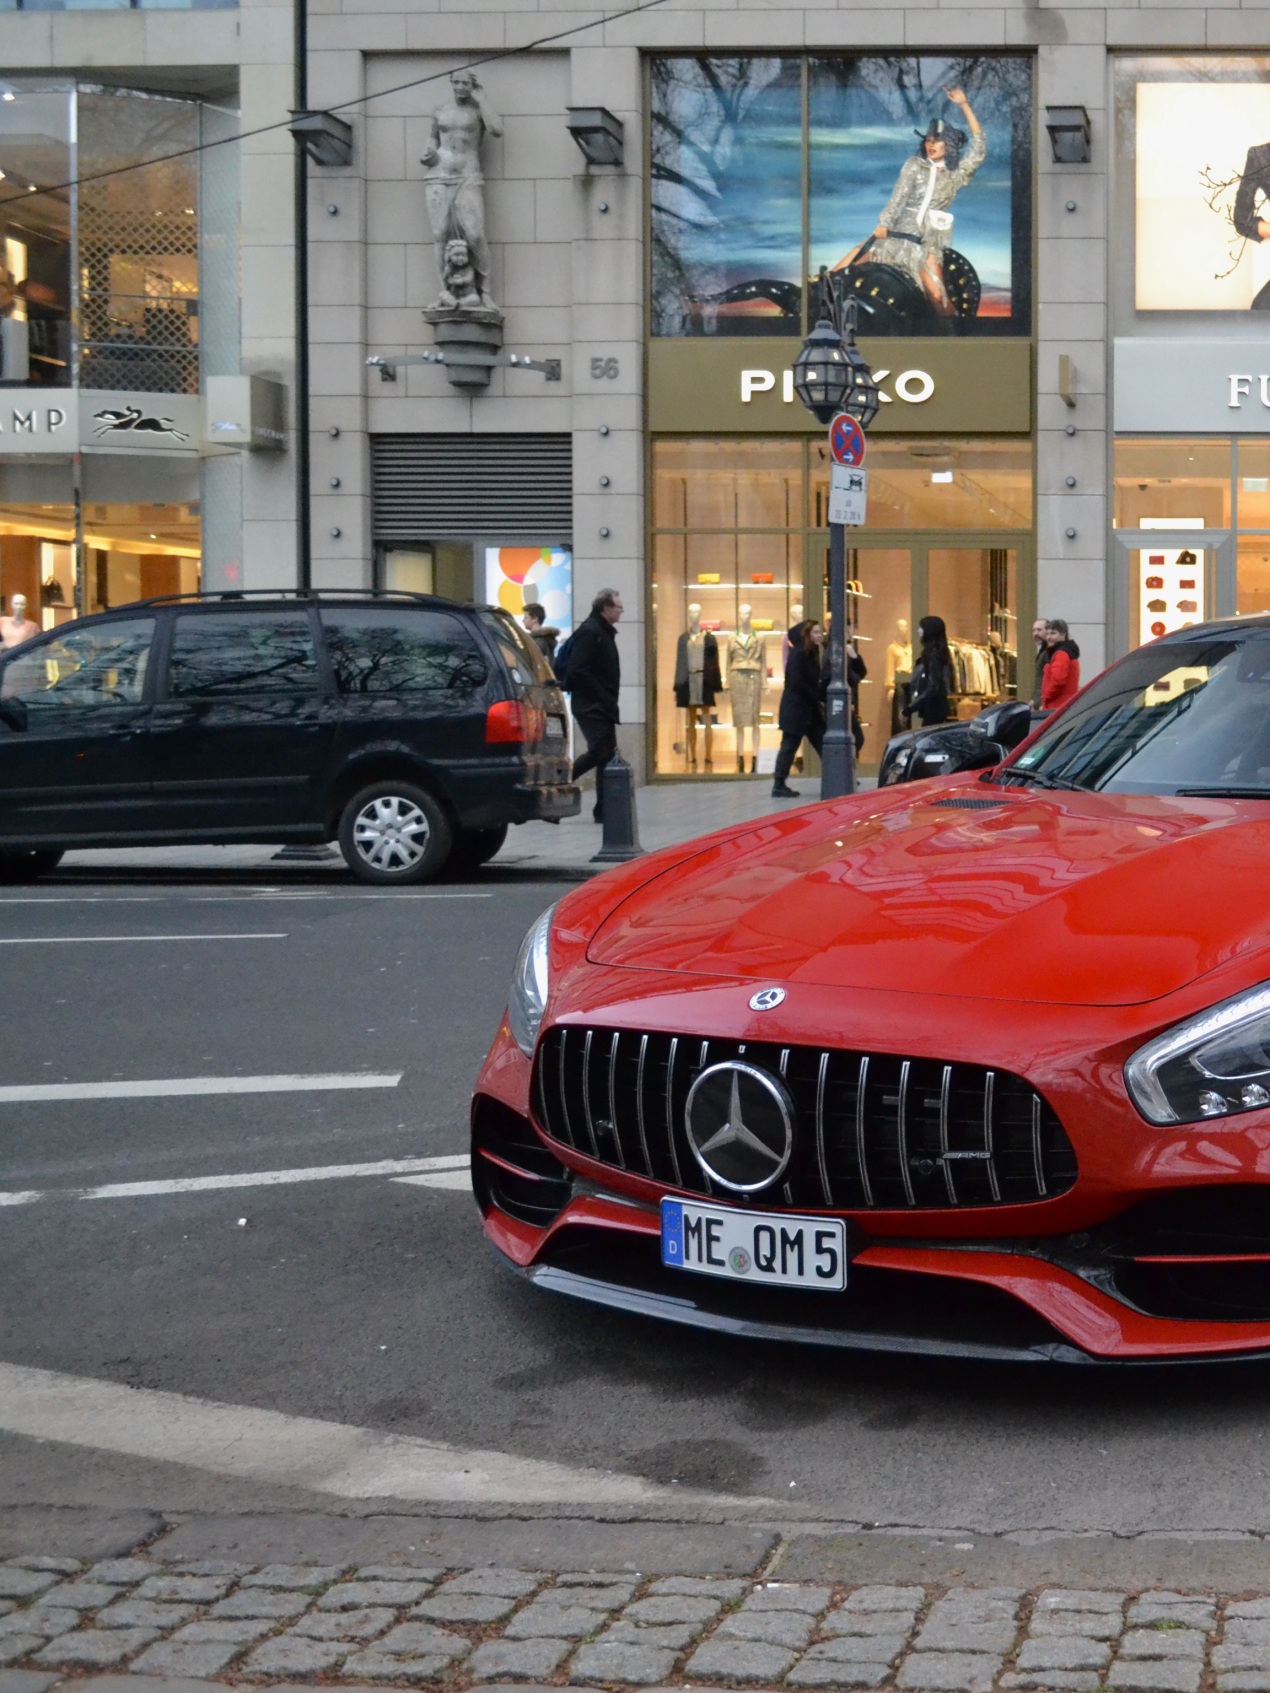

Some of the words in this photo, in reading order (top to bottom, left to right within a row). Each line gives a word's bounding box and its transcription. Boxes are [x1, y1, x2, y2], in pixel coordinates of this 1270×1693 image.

[591, 357, 620, 380] 56
[0, 409, 67, 434] MP
[669, 1240, 678, 1255] D
[683, 1213, 726, 1268] ME
